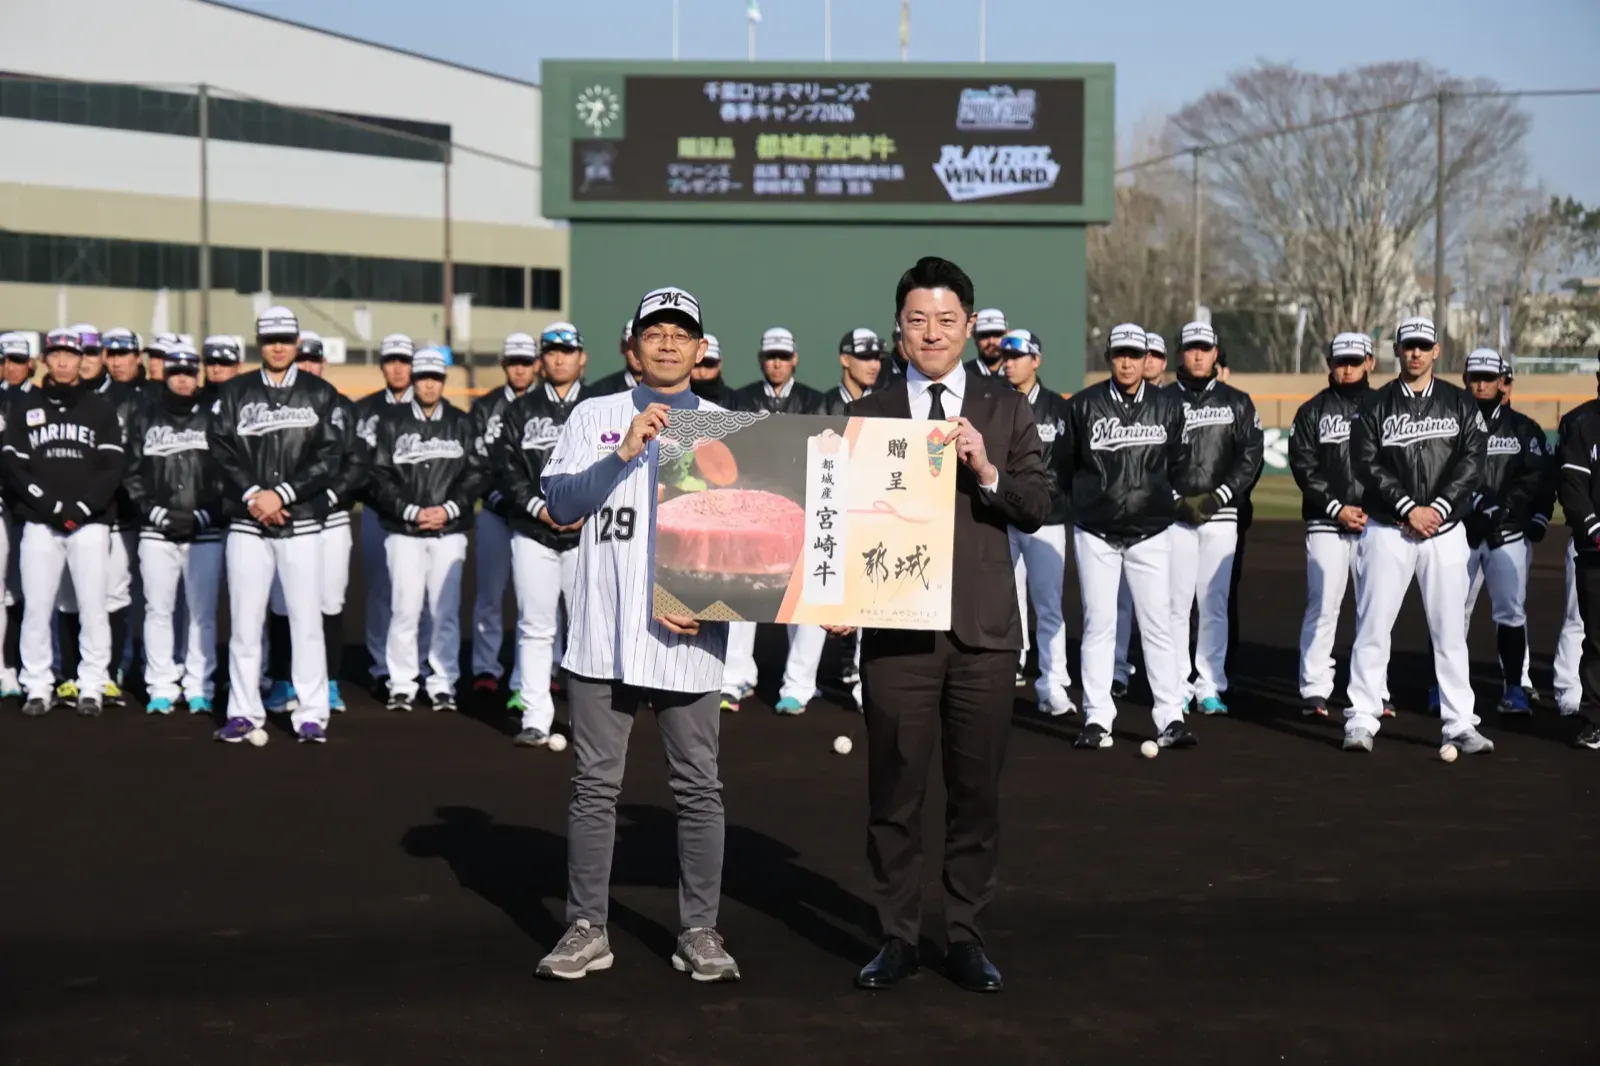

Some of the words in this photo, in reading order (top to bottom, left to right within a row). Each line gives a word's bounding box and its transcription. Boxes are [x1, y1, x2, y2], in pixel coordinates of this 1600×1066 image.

[944, 168, 985, 184] WIN
[990, 168, 1048, 184] HARD
[1090, 417, 1168, 450] Marines
[1382, 413, 1460, 446] Marines
[886, 438, 908, 491] 贈呈
